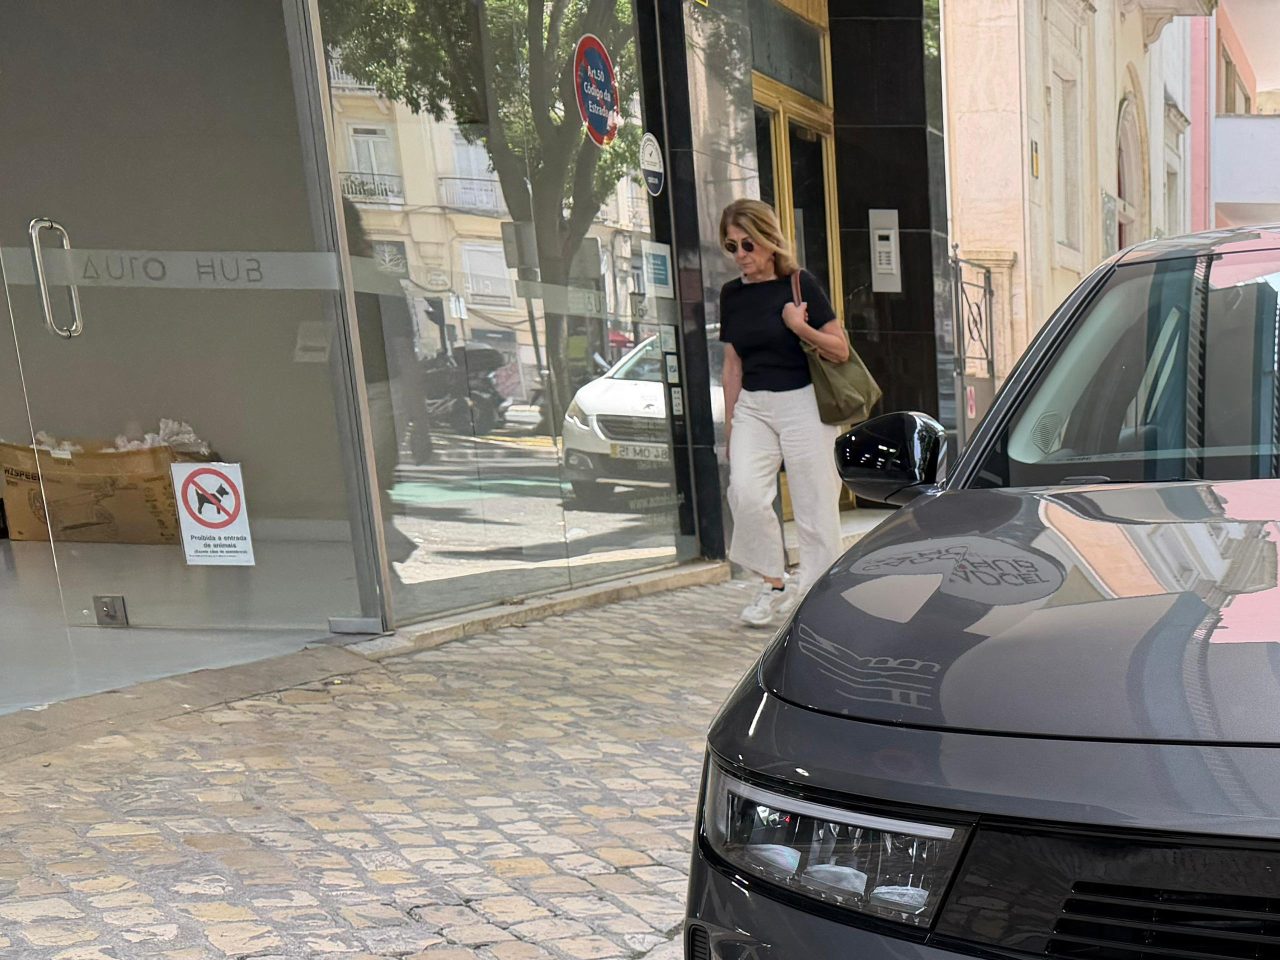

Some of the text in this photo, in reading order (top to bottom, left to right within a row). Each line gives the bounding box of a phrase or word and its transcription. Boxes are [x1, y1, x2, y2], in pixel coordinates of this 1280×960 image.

[583, 81, 611, 102] Código da
[196, 257, 263, 283] HUB
